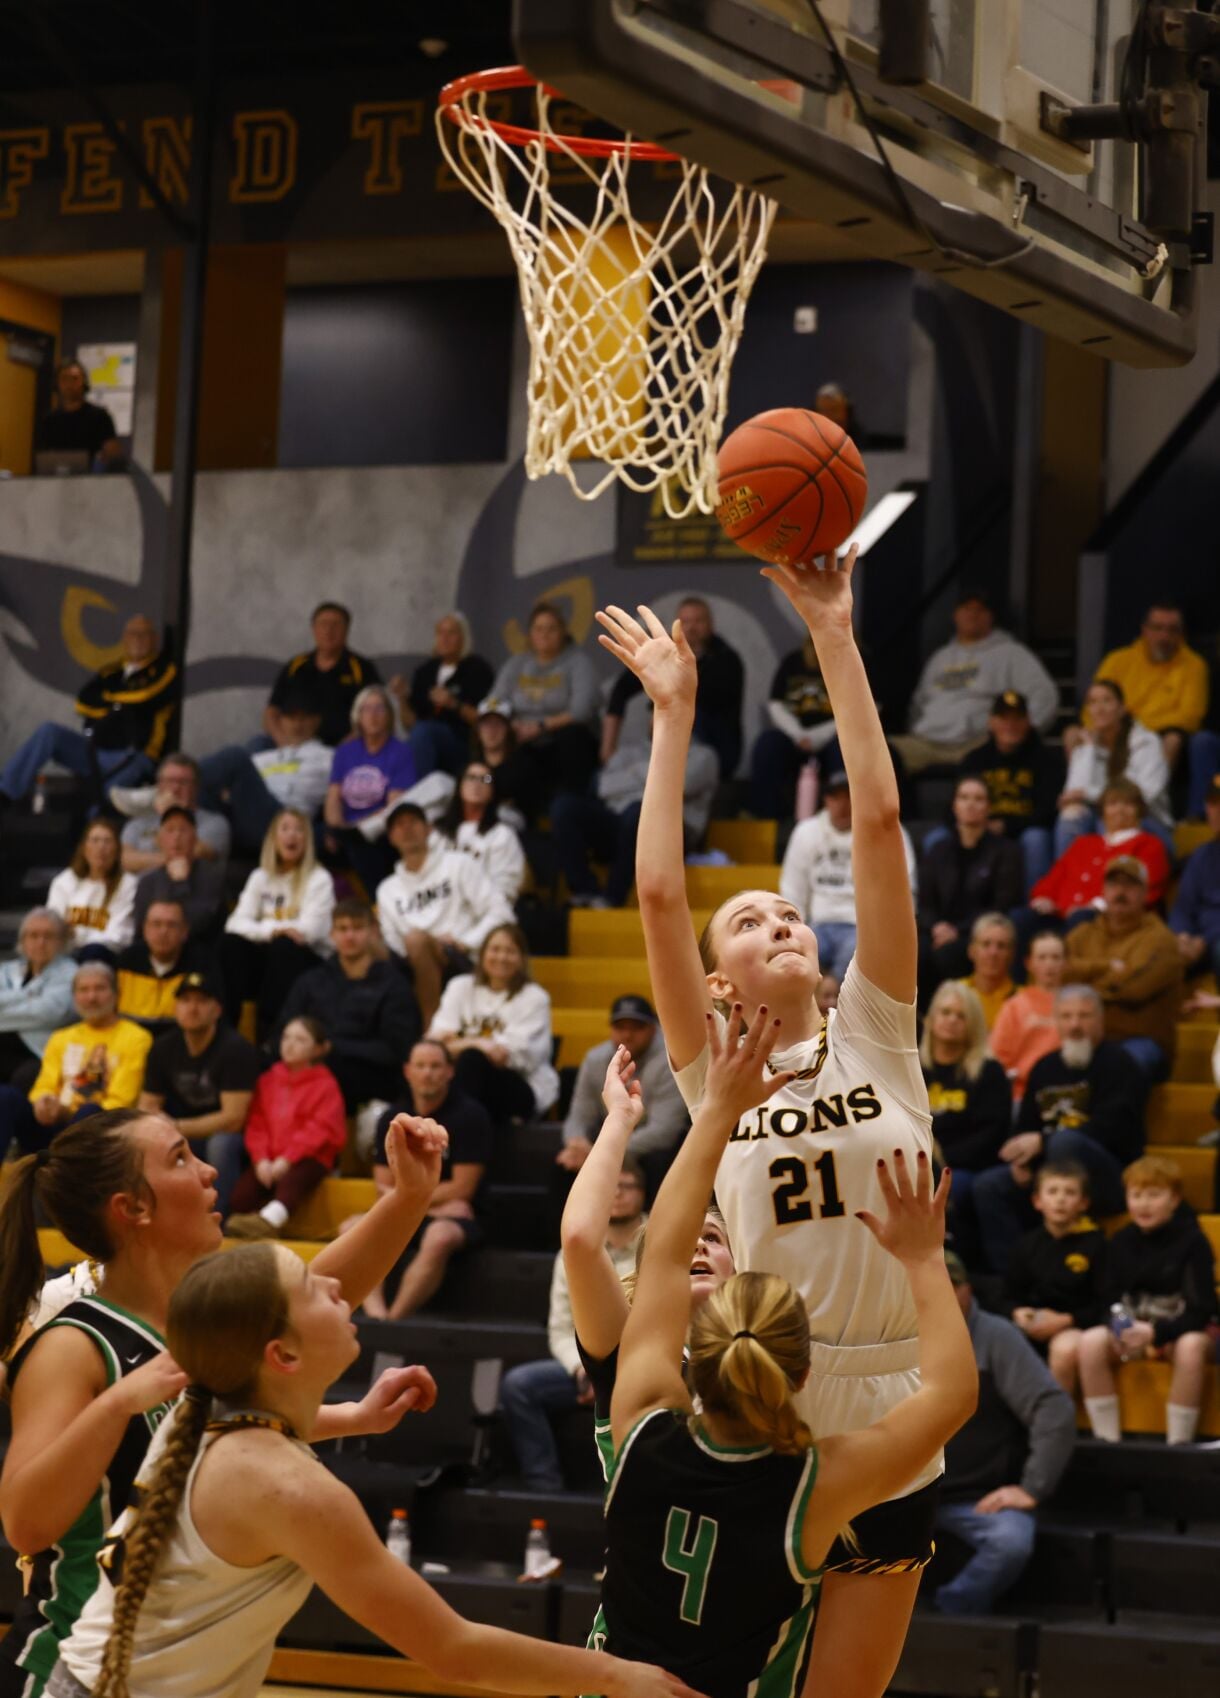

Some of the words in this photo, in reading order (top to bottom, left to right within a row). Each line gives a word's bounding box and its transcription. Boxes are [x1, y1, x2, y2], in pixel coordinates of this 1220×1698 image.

[729, 1083, 882, 1142] LIONS
[768, 1149, 846, 1226] 21
[661, 1505, 719, 1626] 4
